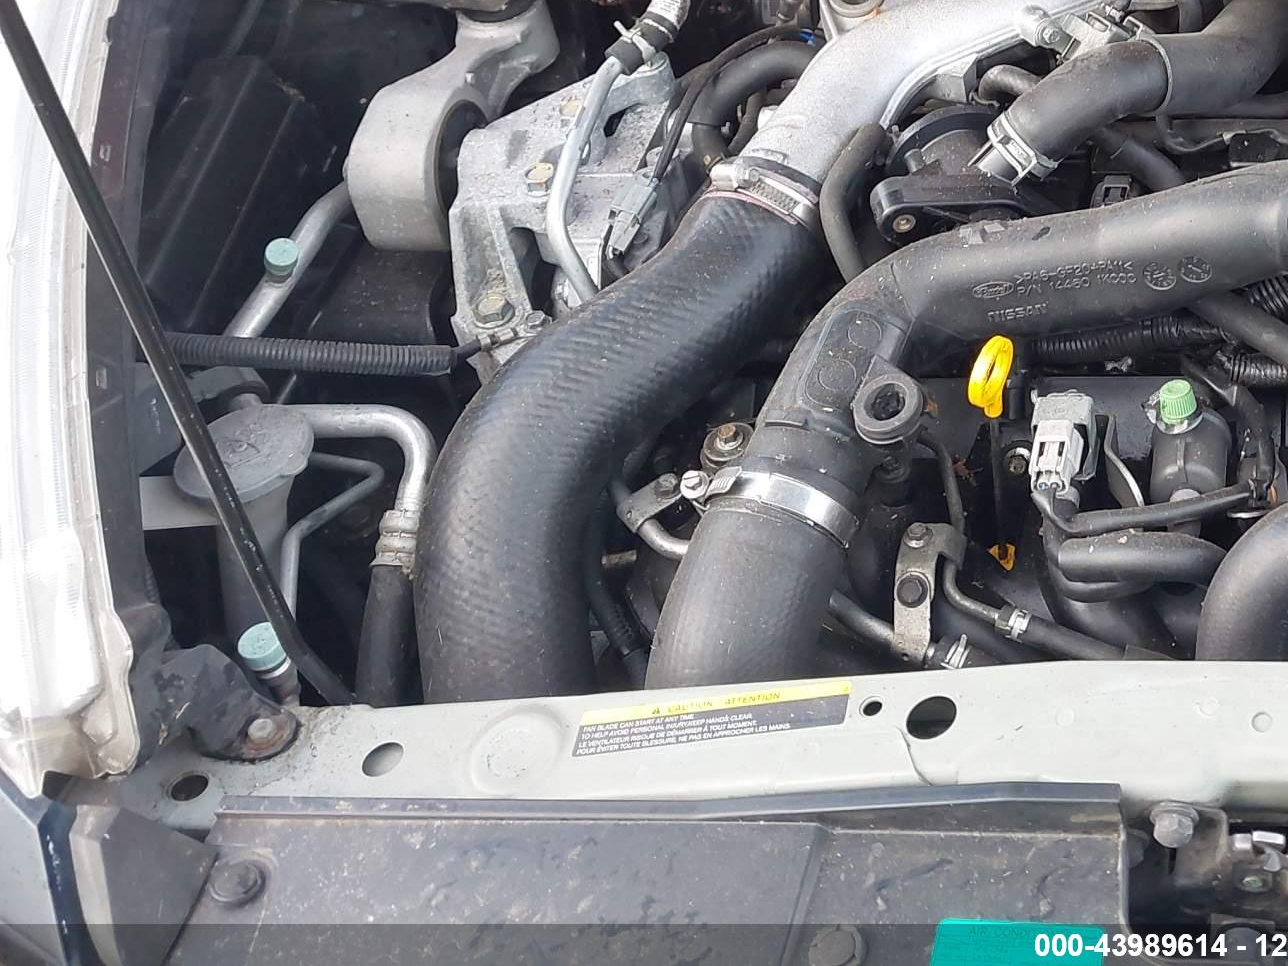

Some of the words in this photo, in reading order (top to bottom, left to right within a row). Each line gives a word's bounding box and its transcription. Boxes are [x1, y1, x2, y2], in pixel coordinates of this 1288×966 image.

[725, 692, 780, 705] ATTENTION
[583, 725, 596, 733] FAN
[597, 722, 619, 731] BLADE
[620, 720, 634, 728] CAN
[635, 717, 655, 727] START
[591, 731, 609, 739] HELP
[609, 728, 629, 737] AVOID
[631, 724, 664, 734] PERSONAL
[576, 747, 596, 755] POUR
[620, 741, 641, 750] TOUTE
[713, 727, 754, 739] APPROCHER
[588, 736, 630, 747] VENTILATEUR
[631, 733, 655, 742] RISQUE
[709, 723, 727, 732] TOUT
